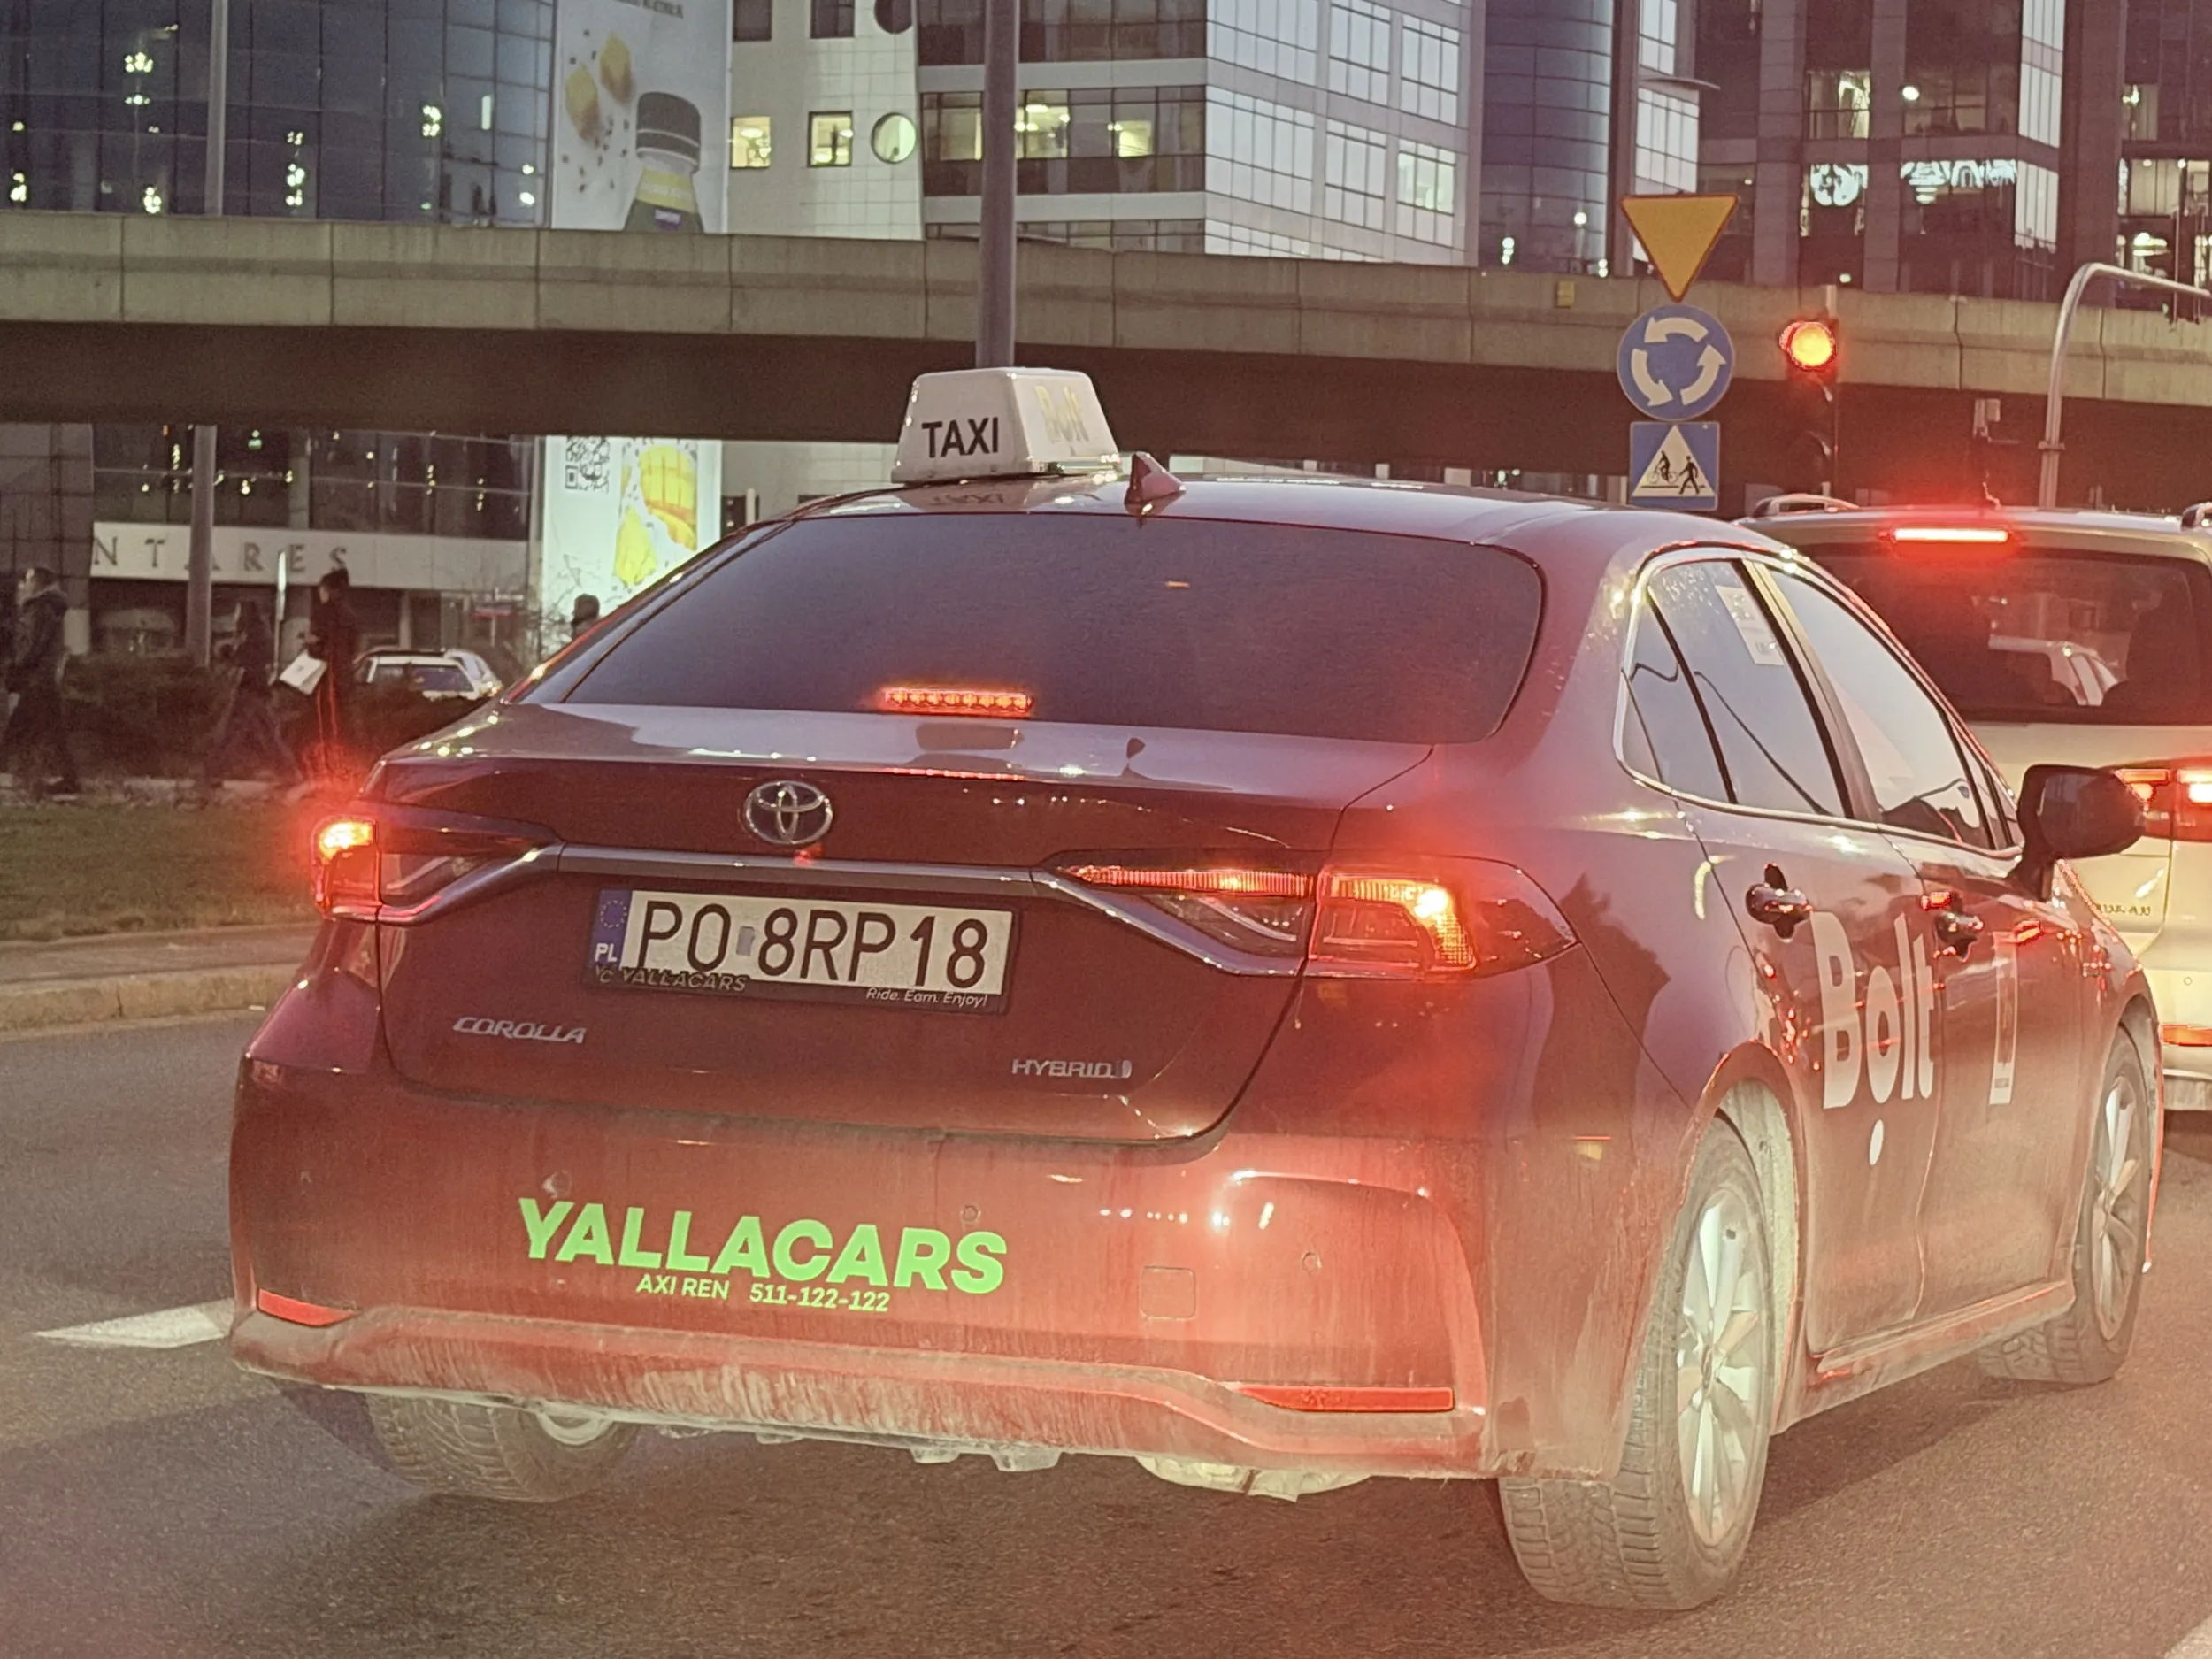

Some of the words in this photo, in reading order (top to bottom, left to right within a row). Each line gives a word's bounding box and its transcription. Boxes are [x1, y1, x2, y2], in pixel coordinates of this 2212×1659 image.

[922, 417, 999, 458] TAXI
[92, 535, 347, 573] NTRES
[595, 942, 618, 962] PL
[635, 899, 732, 973] PO
[757, 907, 988, 989] 8RP18
[621, 968, 748, 992] YALLACARS
[865, 987, 900, 1001] Ride.
[903, 989, 939, 1003] Earn.
[943, 991, 988, 1008] Enjoy!
[1809, 911, 1934, 1110] Bolt
[452, 1016, 588, 1044] COROLLA
[1011, 1058, 1112, 1079] HYBRID
[518, 1197, 1008, 1294] YALLACARS
[635, 1273, 676, 1295] AXI
[681, 1276, 730, 1301] REN
[749, 1282, 891, 1312] 511-122-122
